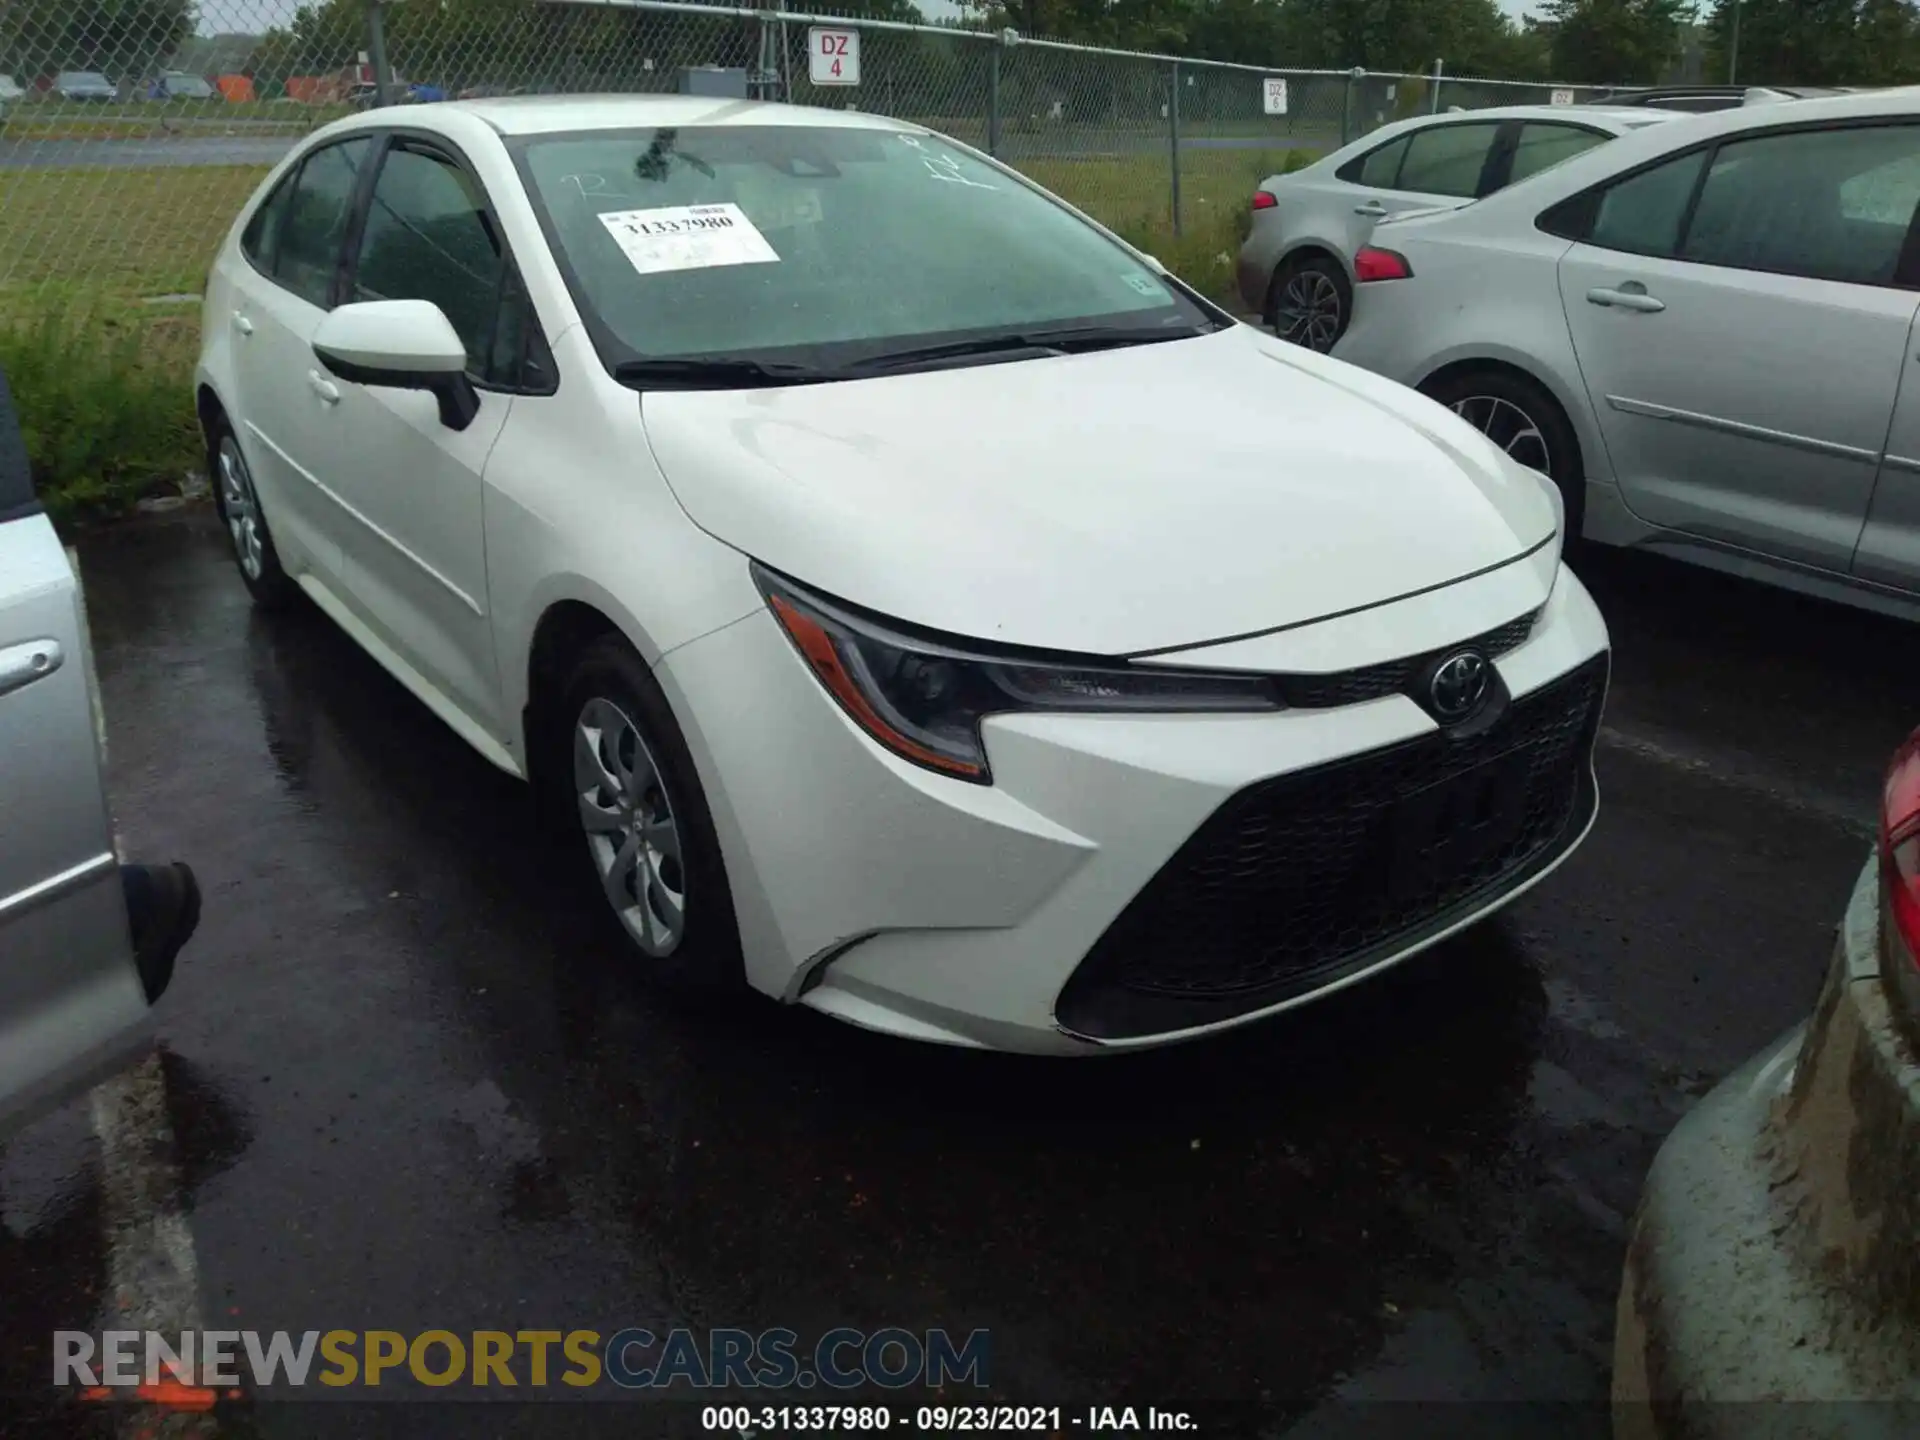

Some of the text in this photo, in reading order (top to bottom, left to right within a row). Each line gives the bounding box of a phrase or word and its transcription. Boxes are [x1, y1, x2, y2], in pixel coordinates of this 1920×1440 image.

[821, 34, 849, 56] DZ
[831, 58, 843, 77] 4
[623, 214, 734, 236] 31337980
